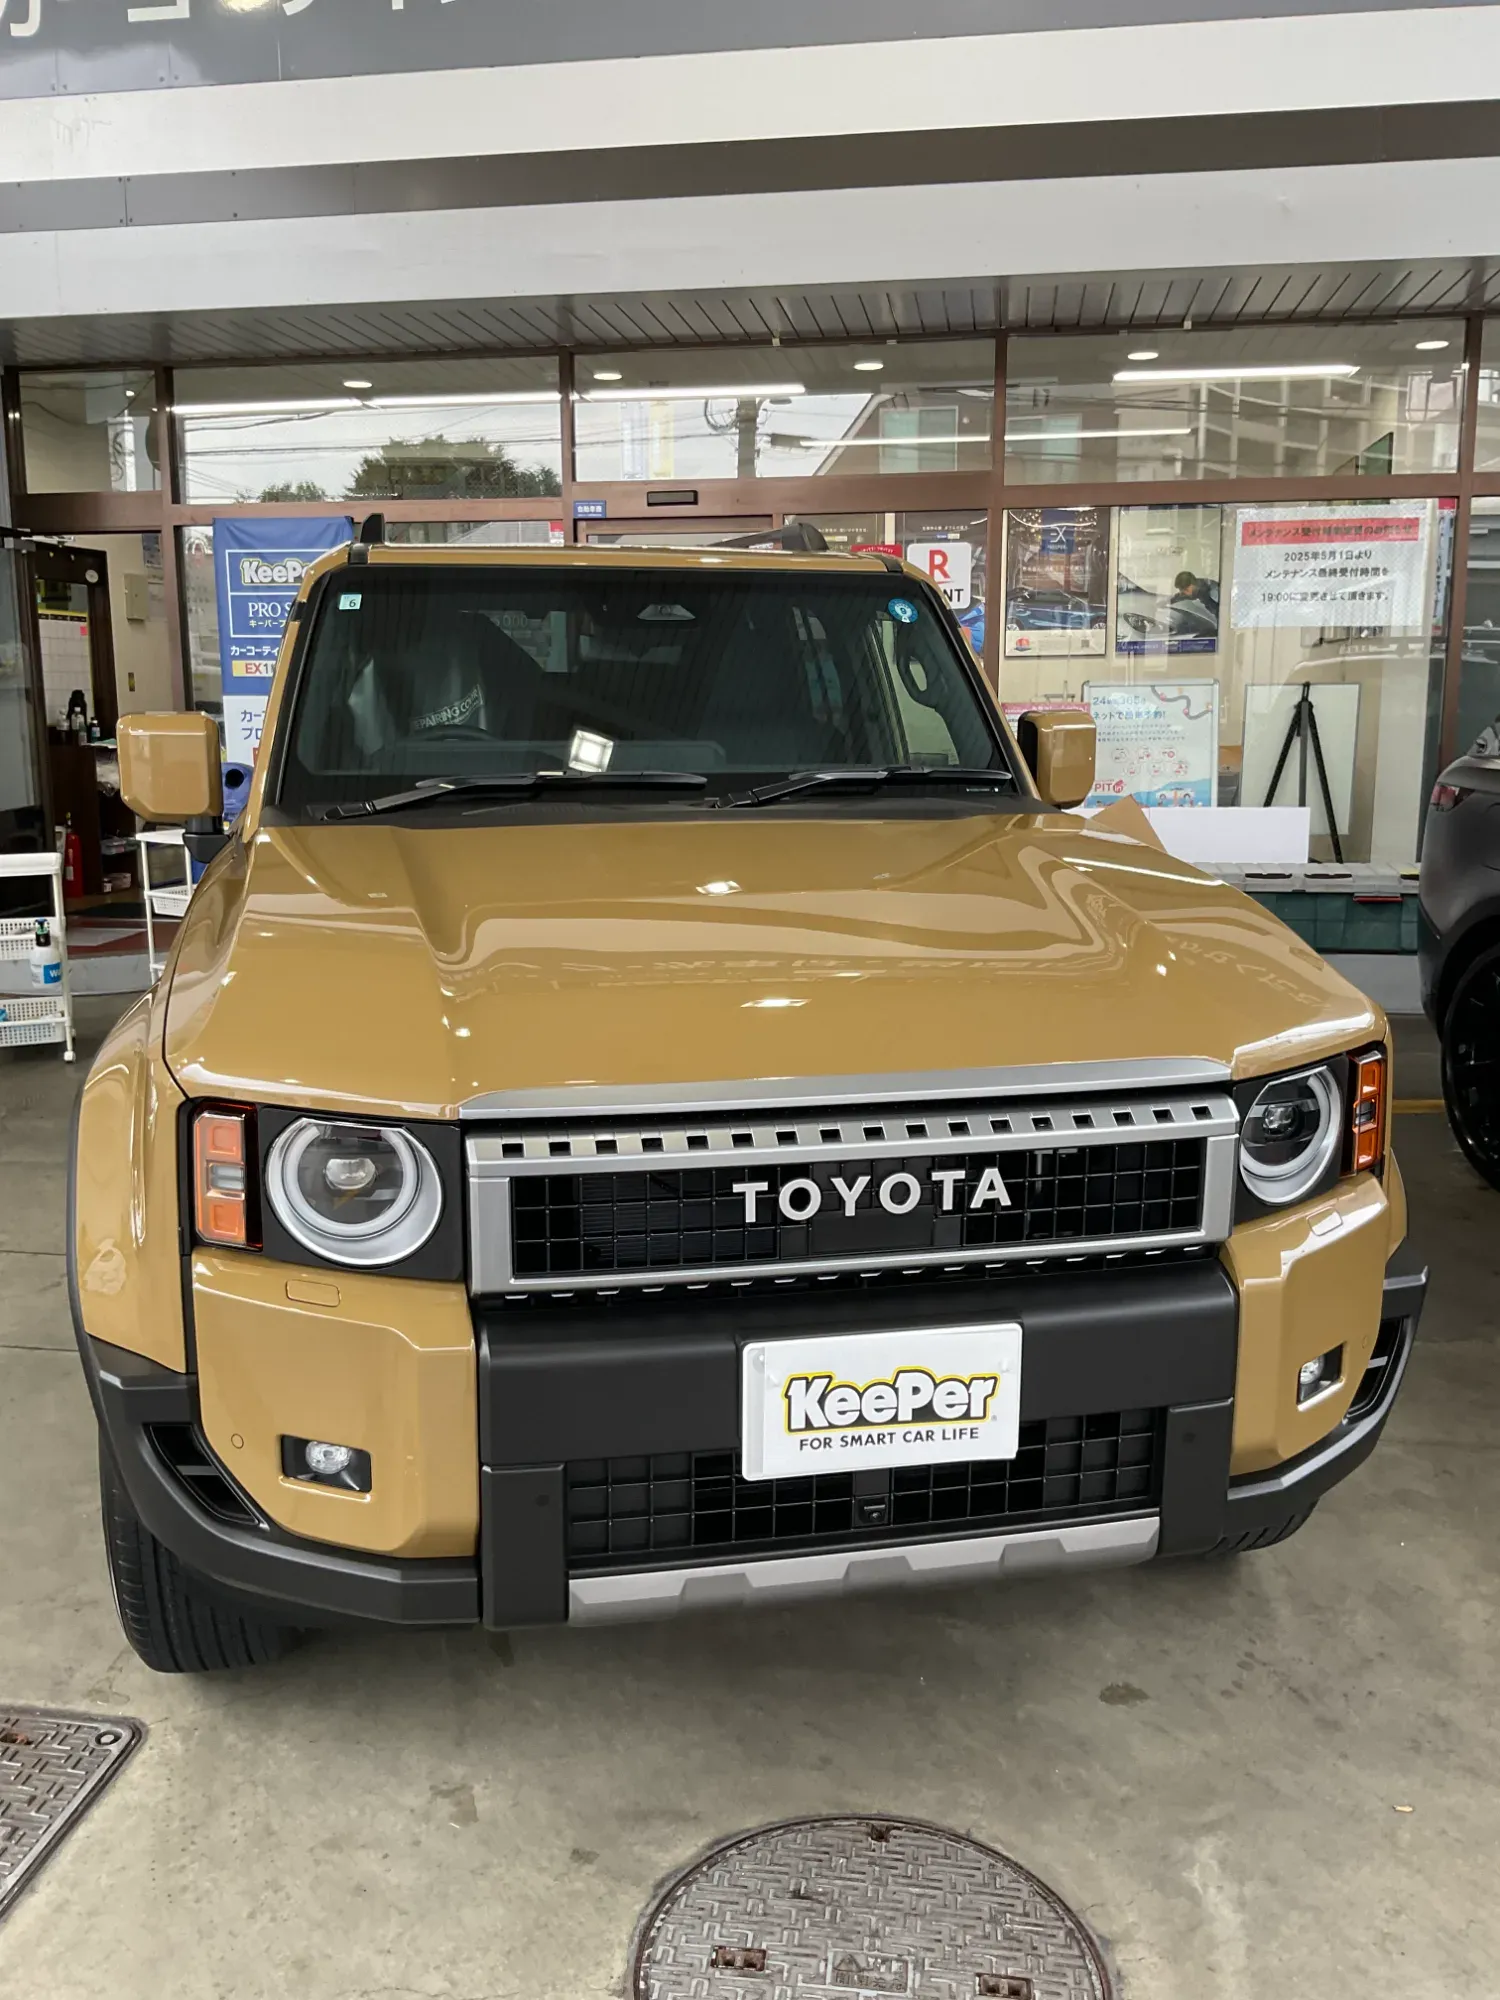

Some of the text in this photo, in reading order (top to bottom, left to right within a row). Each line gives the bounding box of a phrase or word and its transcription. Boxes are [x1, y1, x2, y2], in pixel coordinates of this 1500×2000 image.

[929, 549, 951, 579] R
[1284, 550, 1373, 562] 2025年5月1日より
[248, 602, 281, 617] PRO
[348, 598, 357, 608] 6
[732, 1167, 1012, 1223] TOYOTA
[782, 1366, 999, 1435] KeePer
[799, 1427, 979, 1451] FOR SMART CAR LIFE
